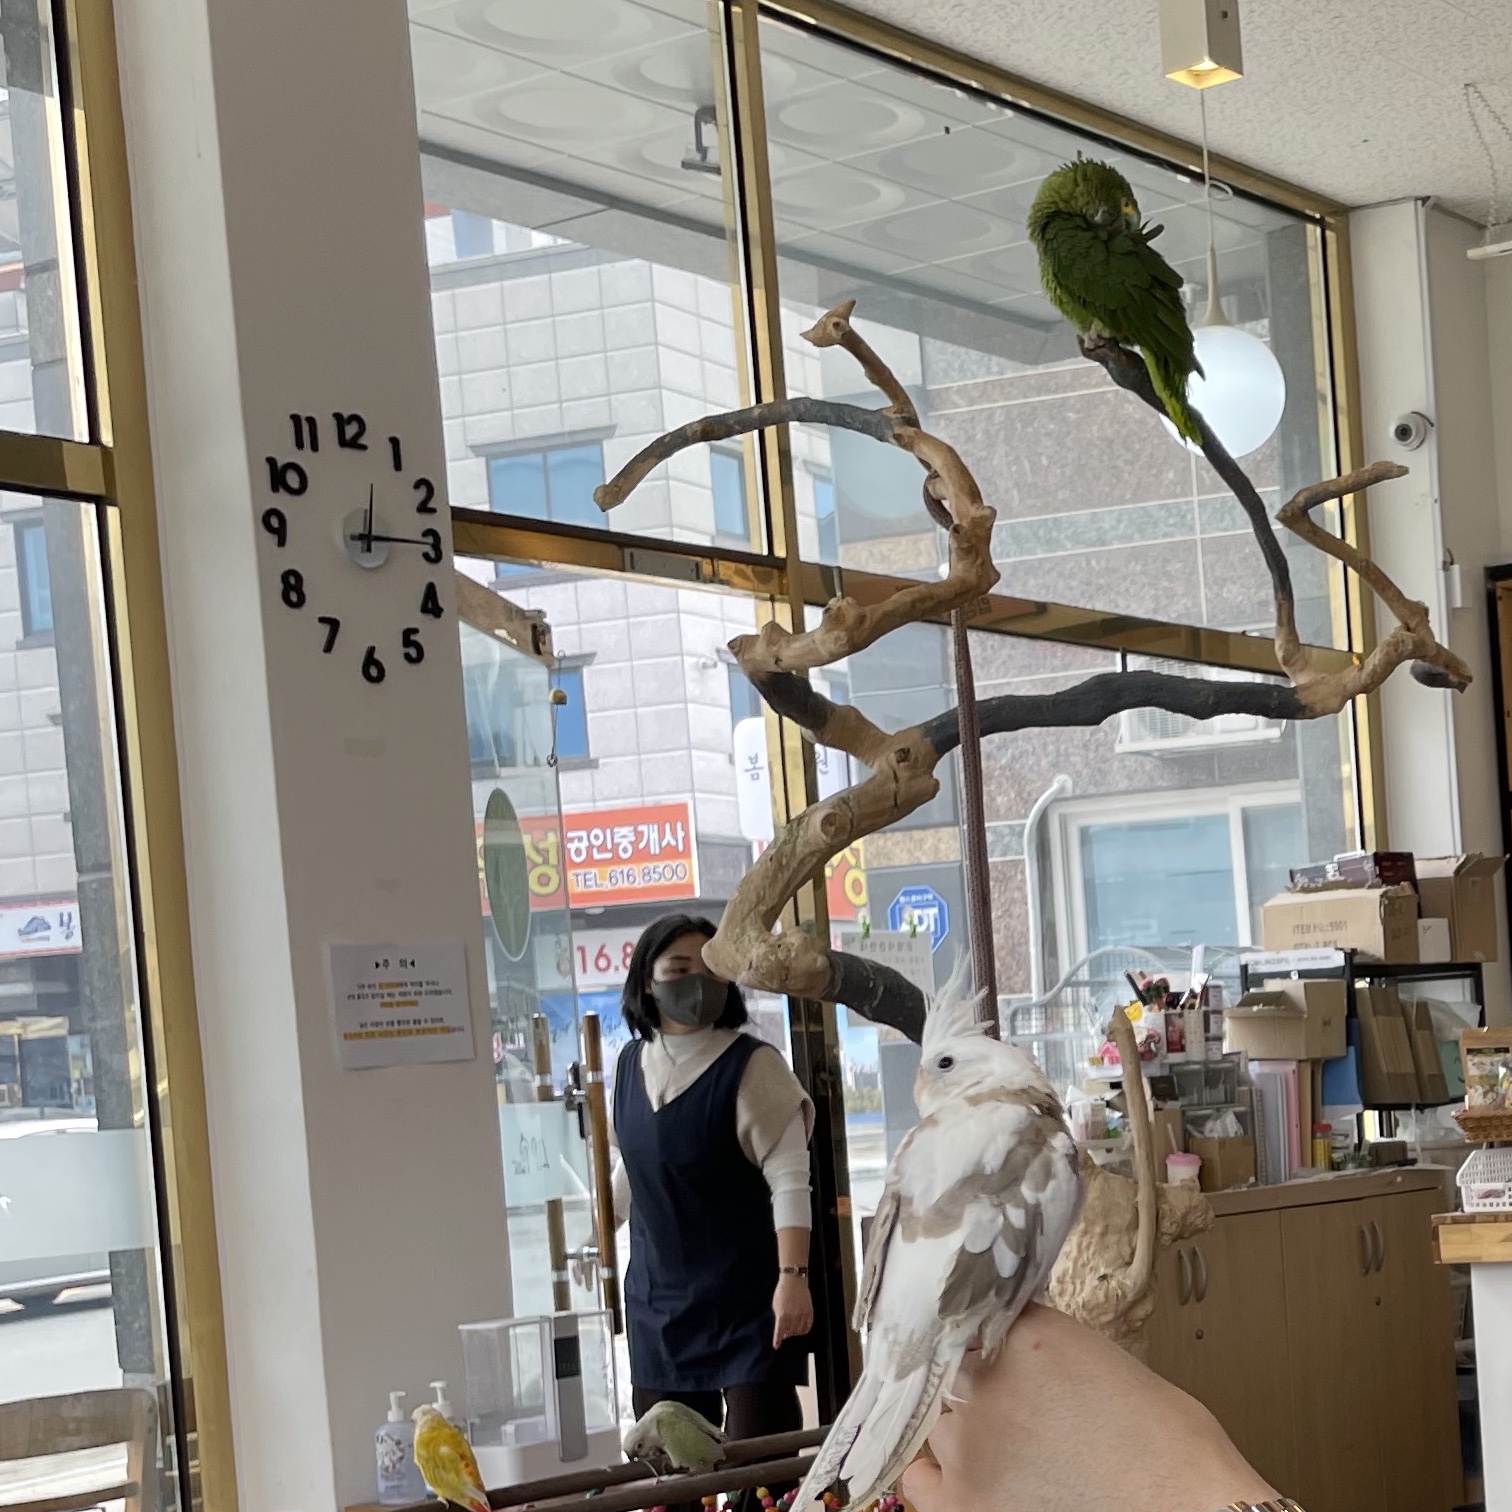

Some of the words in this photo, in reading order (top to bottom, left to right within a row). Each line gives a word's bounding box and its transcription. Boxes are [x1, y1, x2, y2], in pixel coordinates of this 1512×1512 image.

[289, 413, 320, 453] 11
[332, 412, 368, 451] 12
[388, 436, 402, 472] 1
[265, 456, 308, 496] 10
[413, 477, 437, 514] 2
[261, 507, 288, 548] 9
[421, 528, 443, 564] 3
[280, 568, 307, 609] 8
[420, 581, 444, 619] 4
[318, 616, 341, 653] 7
[402, 627, 425, 664] 5
[361, 645, 386, 684] 6
[566, 820, 686, 864] 공인중개사
